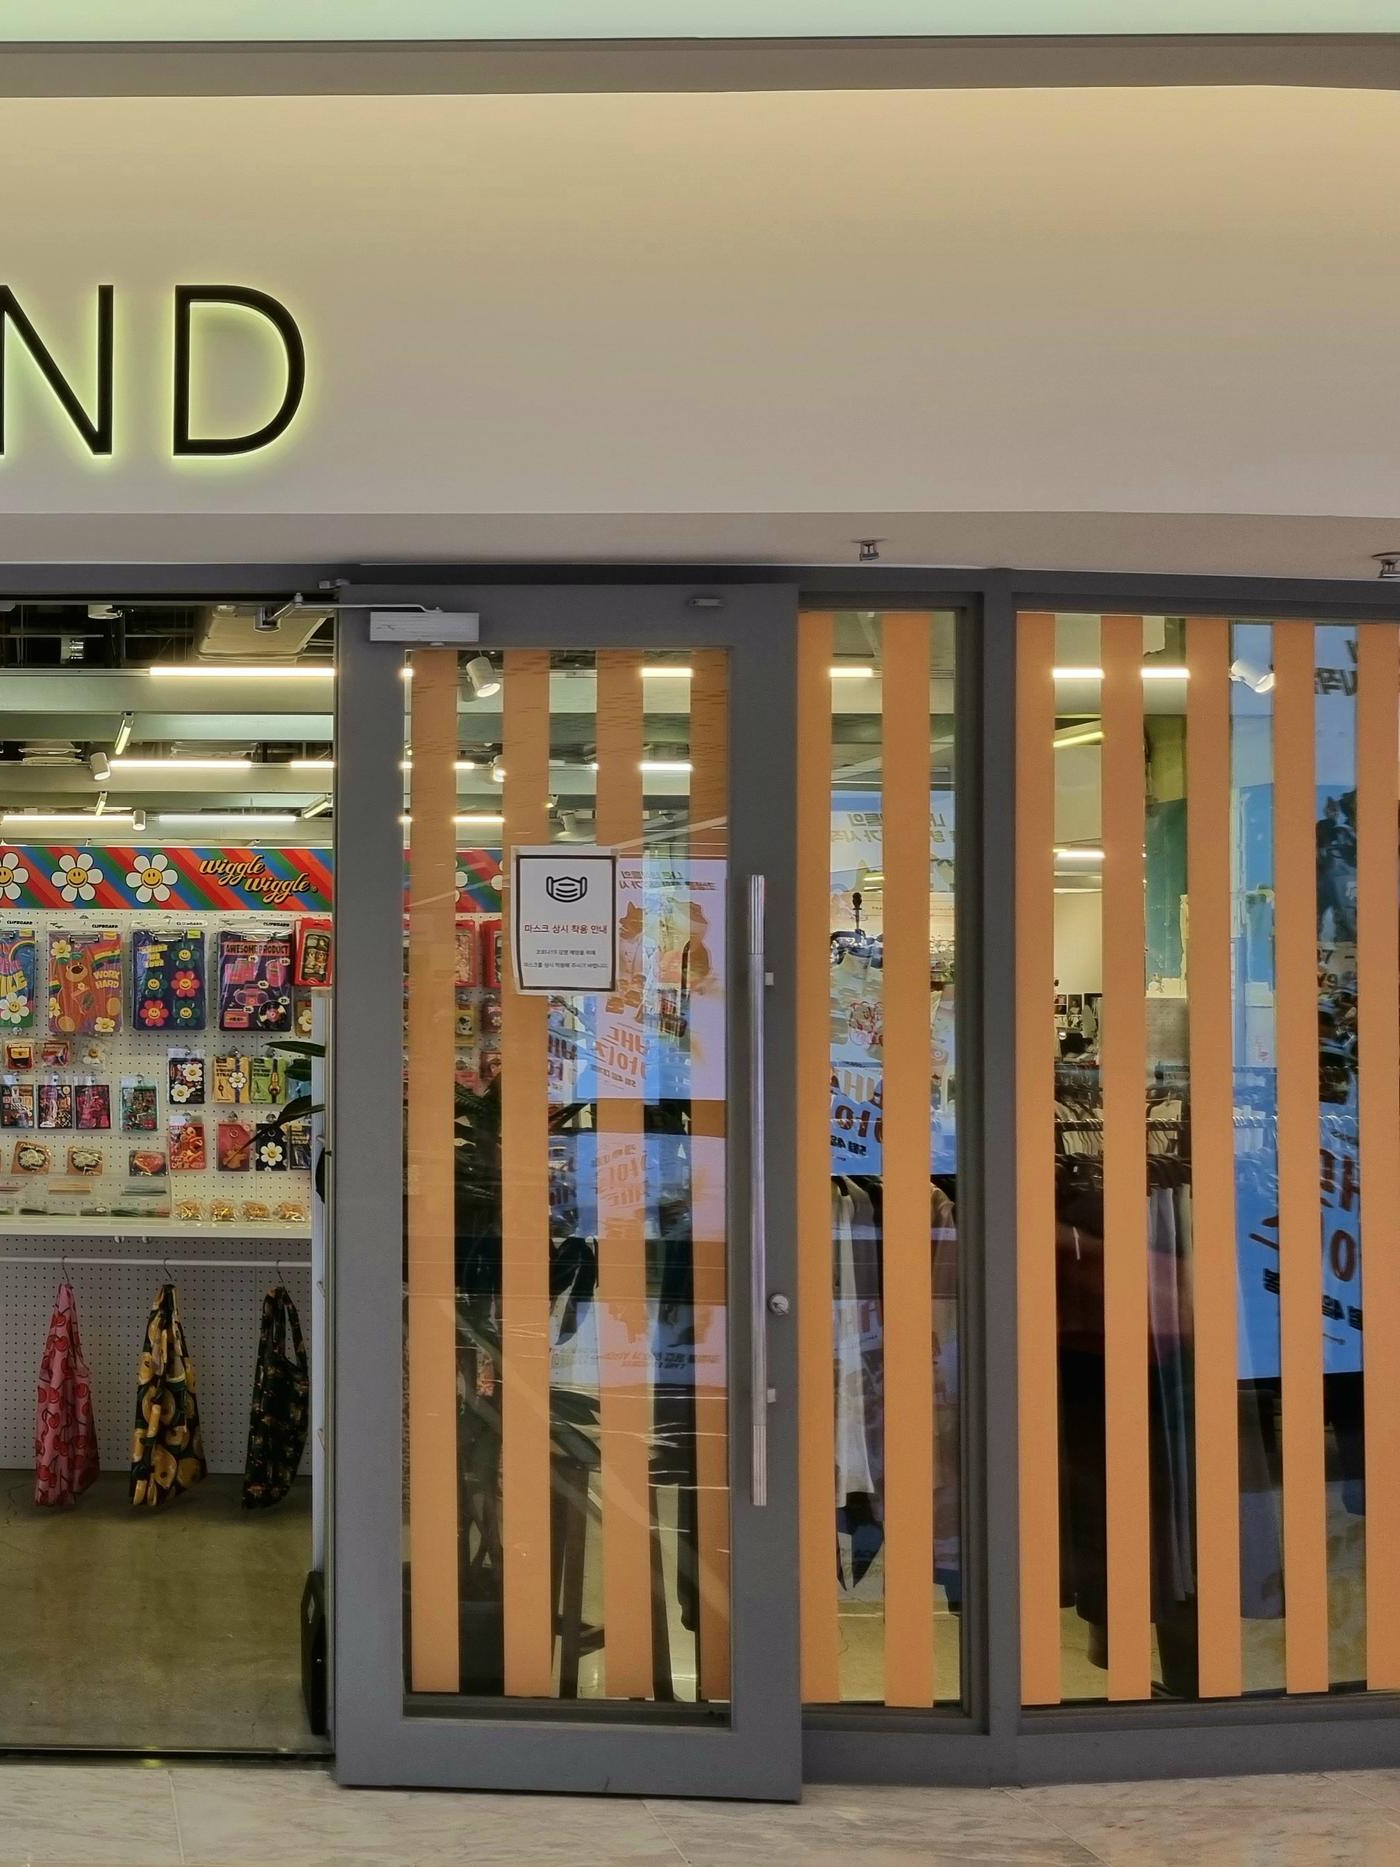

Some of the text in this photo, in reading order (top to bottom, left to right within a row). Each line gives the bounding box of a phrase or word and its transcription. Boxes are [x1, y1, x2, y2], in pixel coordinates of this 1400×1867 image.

[199, 855, 266, 886] wiggle
[244, 872, 311, 904] wiggle
[524, 924, 608, 935] 마스크 상시 착용 안내
[225, 944, 290, 955] AWESOME PRODUCT
[92, 969, 121, 980] WORK
[95, 979, 120, 990] HARD
